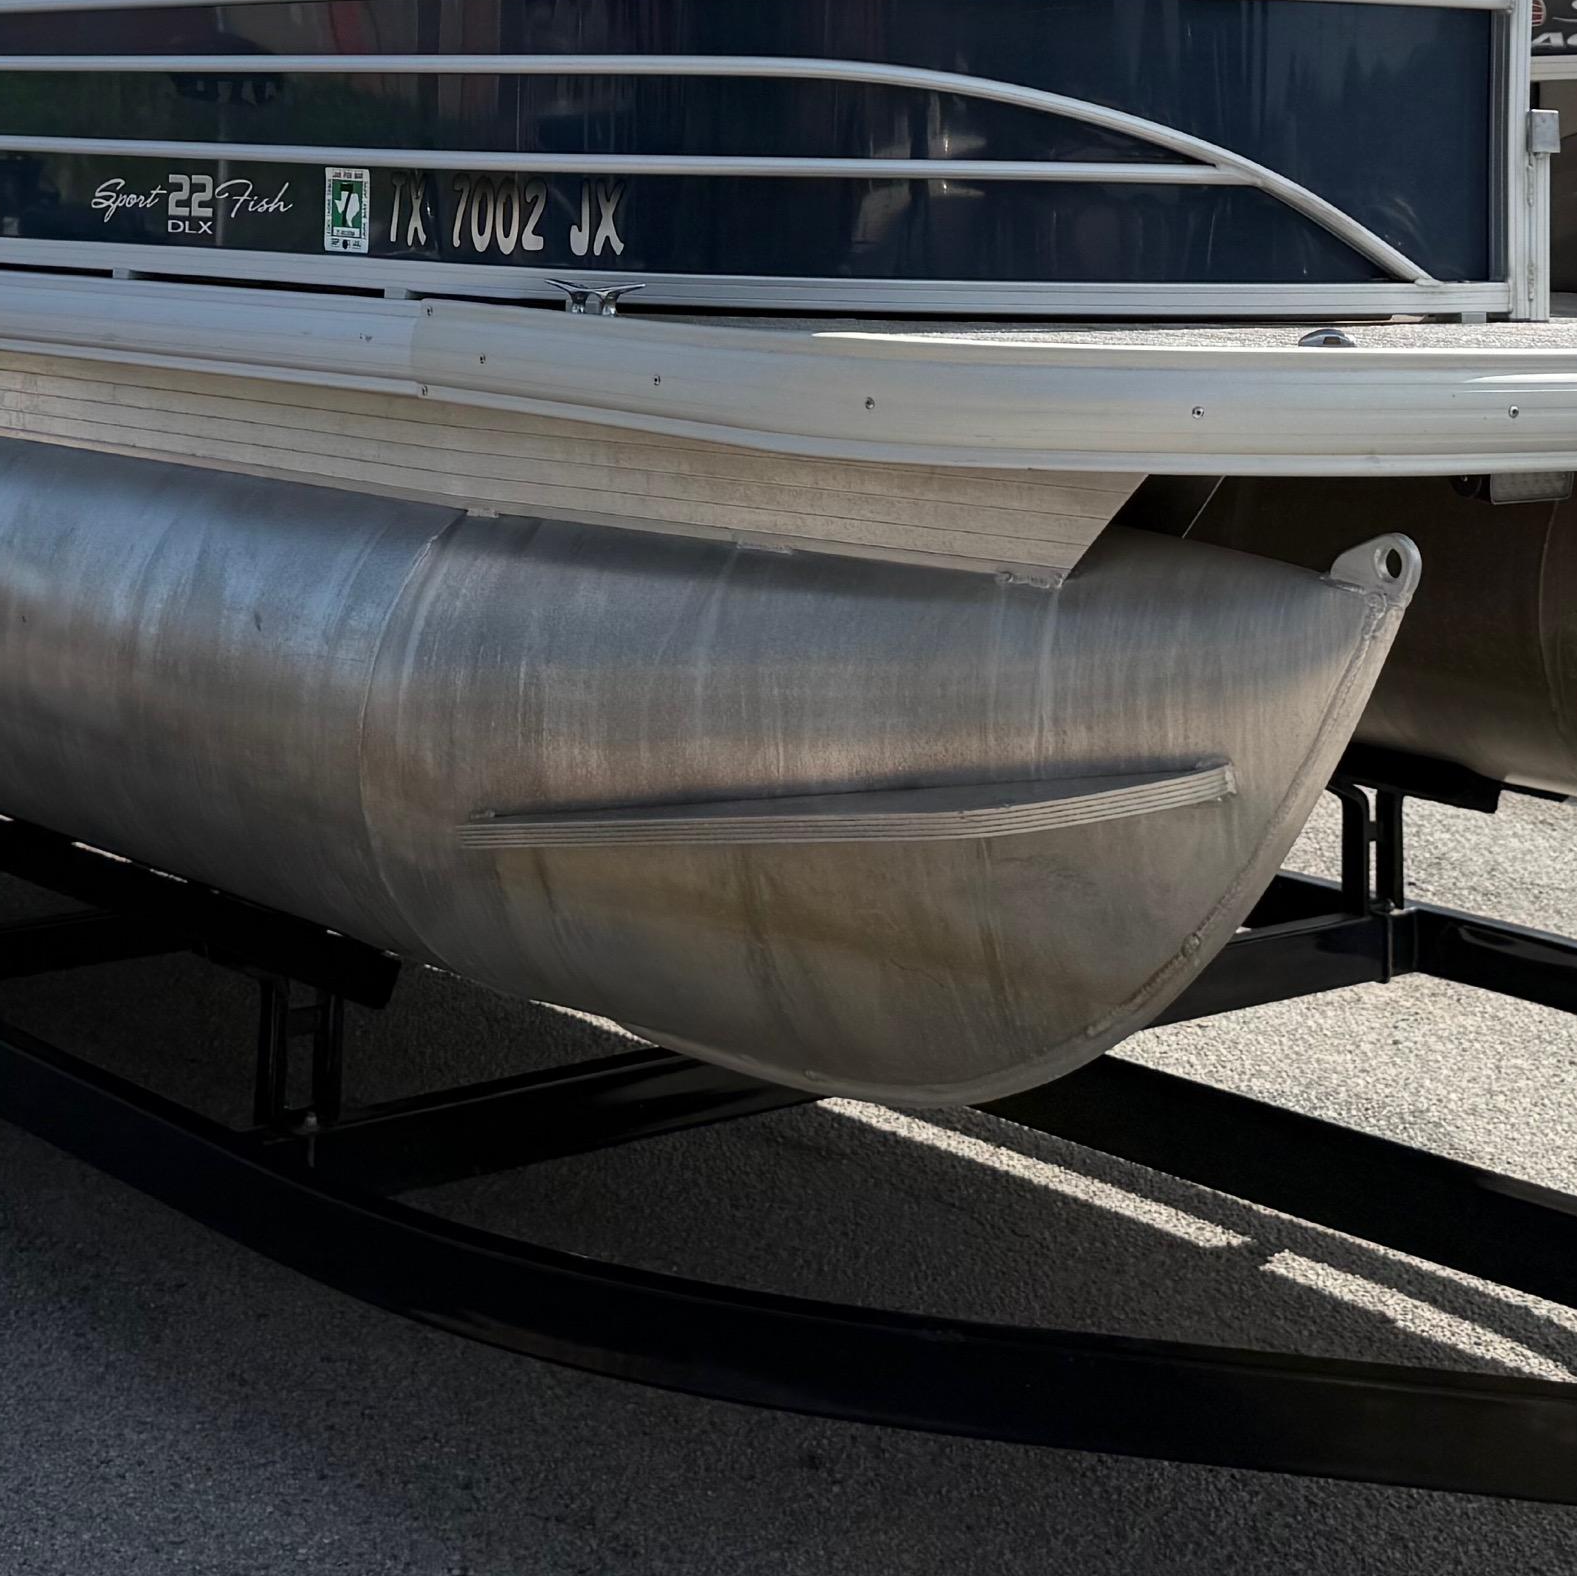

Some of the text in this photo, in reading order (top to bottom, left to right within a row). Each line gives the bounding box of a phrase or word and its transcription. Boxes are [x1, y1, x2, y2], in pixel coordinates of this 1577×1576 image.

[91, 178, 167, 222] Sport
[168, 174, 213, 217] 22
[214, 179, 293, 218] Fish
[389, 173, 427, 247] TX
[452, 174, 548, 255] 7002
[569, 177, 626, 256] JX
[167, 219, 214, 235] DLX
